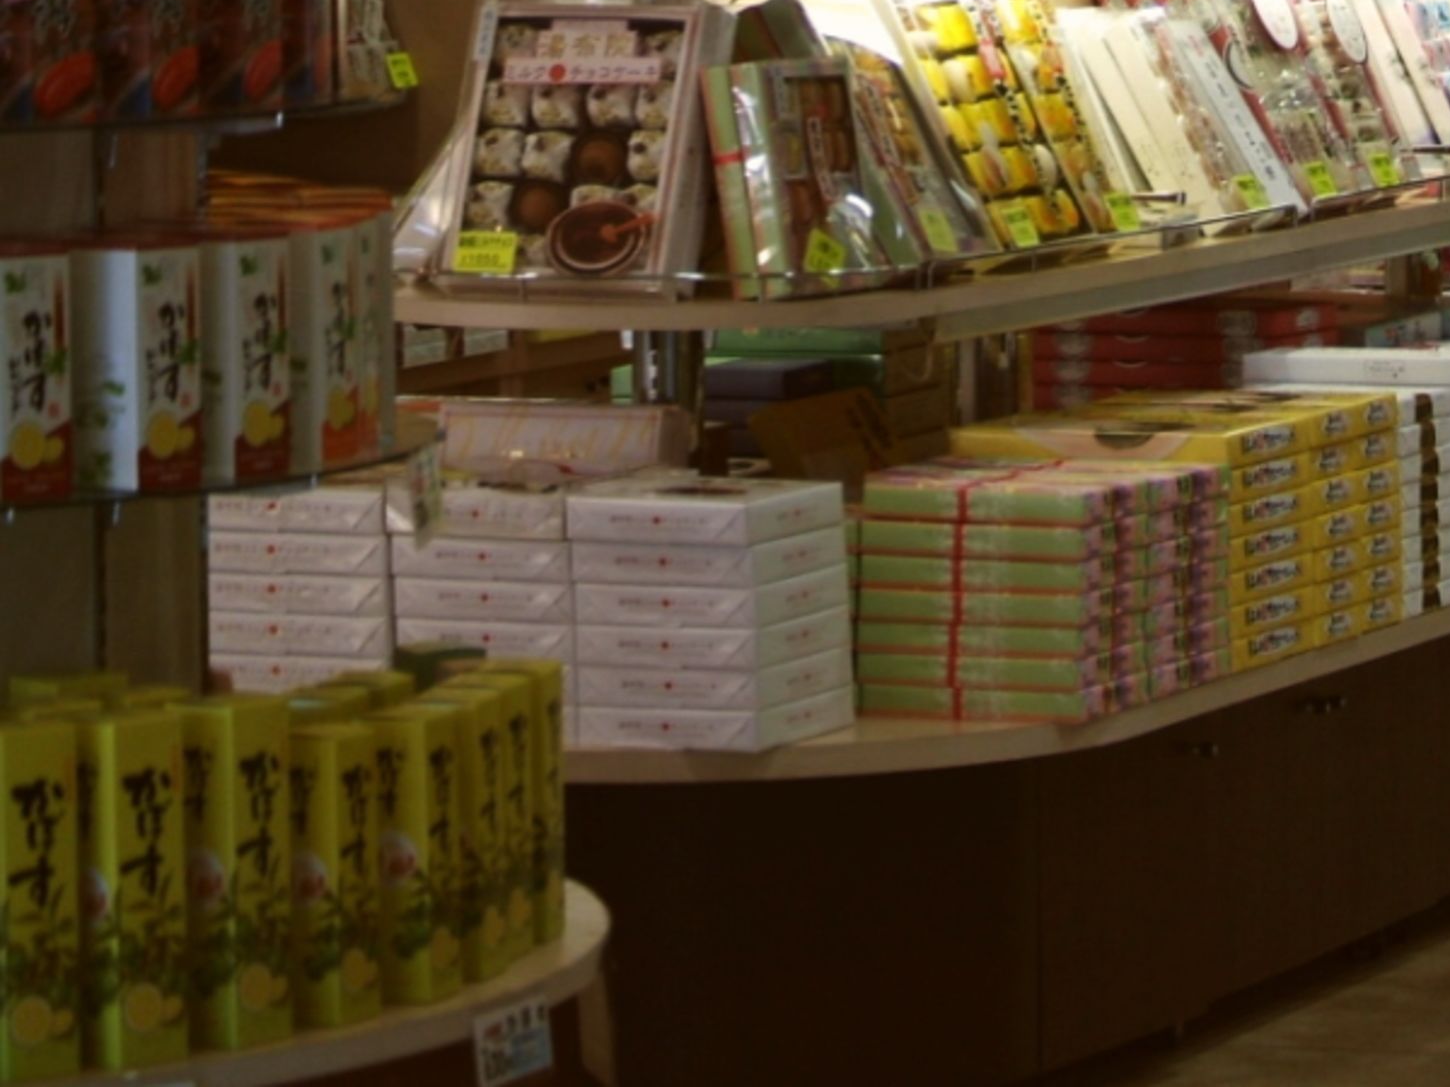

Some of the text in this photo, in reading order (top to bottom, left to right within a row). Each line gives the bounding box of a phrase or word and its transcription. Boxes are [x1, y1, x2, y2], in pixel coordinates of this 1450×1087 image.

[8, 778, 65, 908] かぼす
[120, 765, 172, 896] かぼす
[236, 750, 280, 878] かぼす
